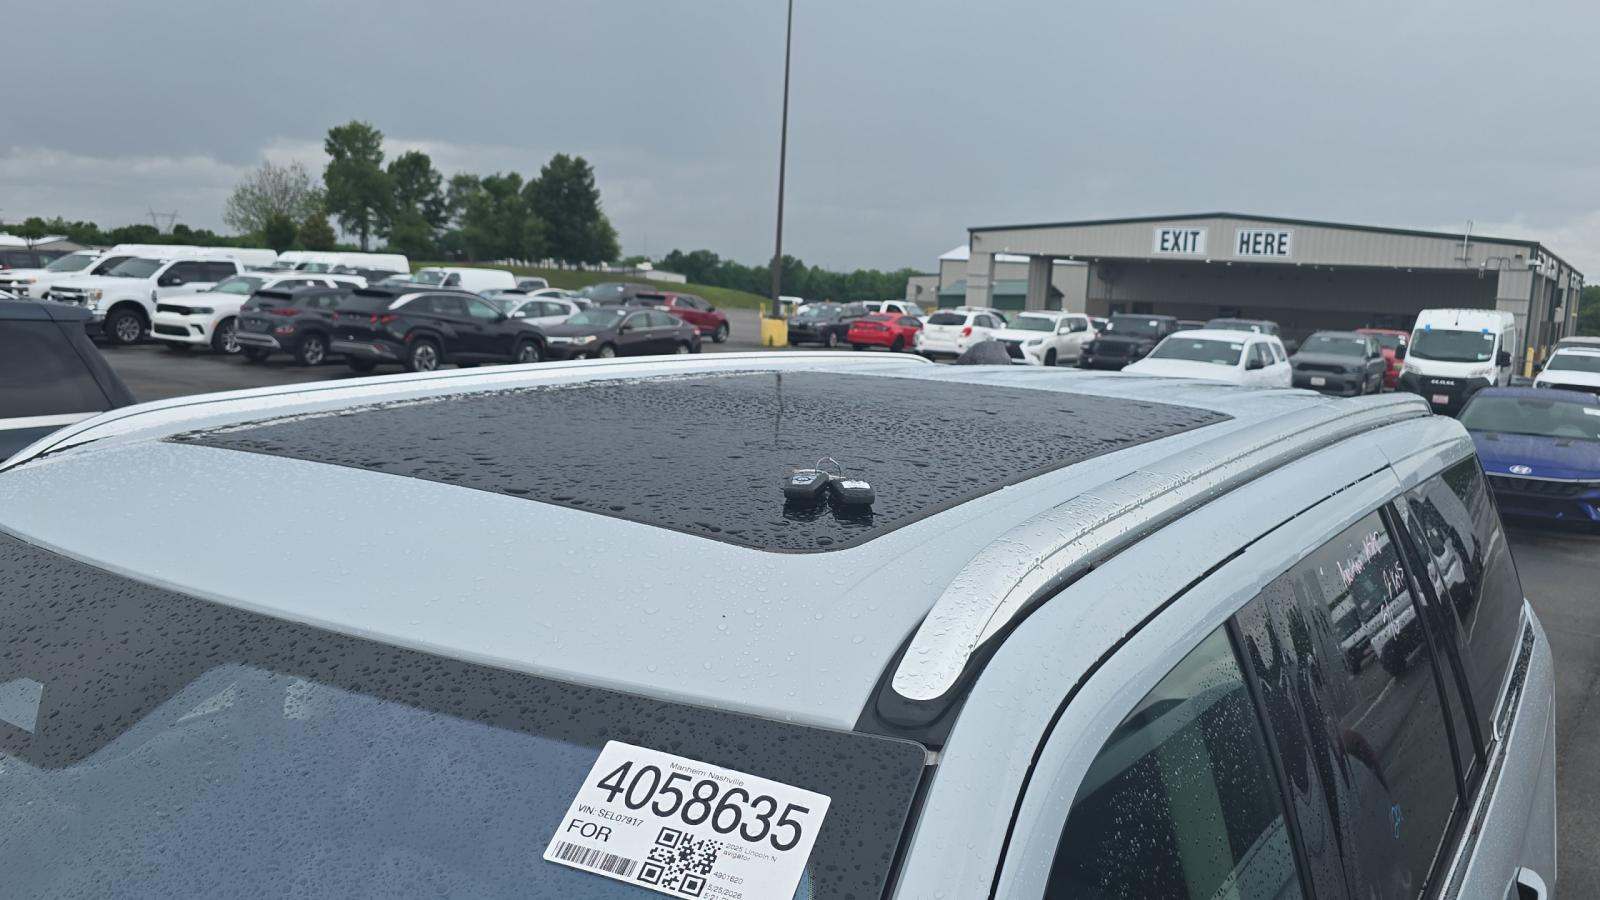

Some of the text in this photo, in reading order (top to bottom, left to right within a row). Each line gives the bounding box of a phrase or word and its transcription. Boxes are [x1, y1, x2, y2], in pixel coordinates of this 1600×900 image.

[1160, 230, 1288, 255] EXIT HERE
[669, 762, 745, 787] Manheim Nashville
[577, 803, 645, 828] VIN: SEL07917
[597, 760, 810, 851] 4058635
[566, 818, 613, 842] FOR
[722, 850, 751, 862] avigator
[725, 842, 744, 852] 2025
[744, 847, 770, 861] Lincoln
